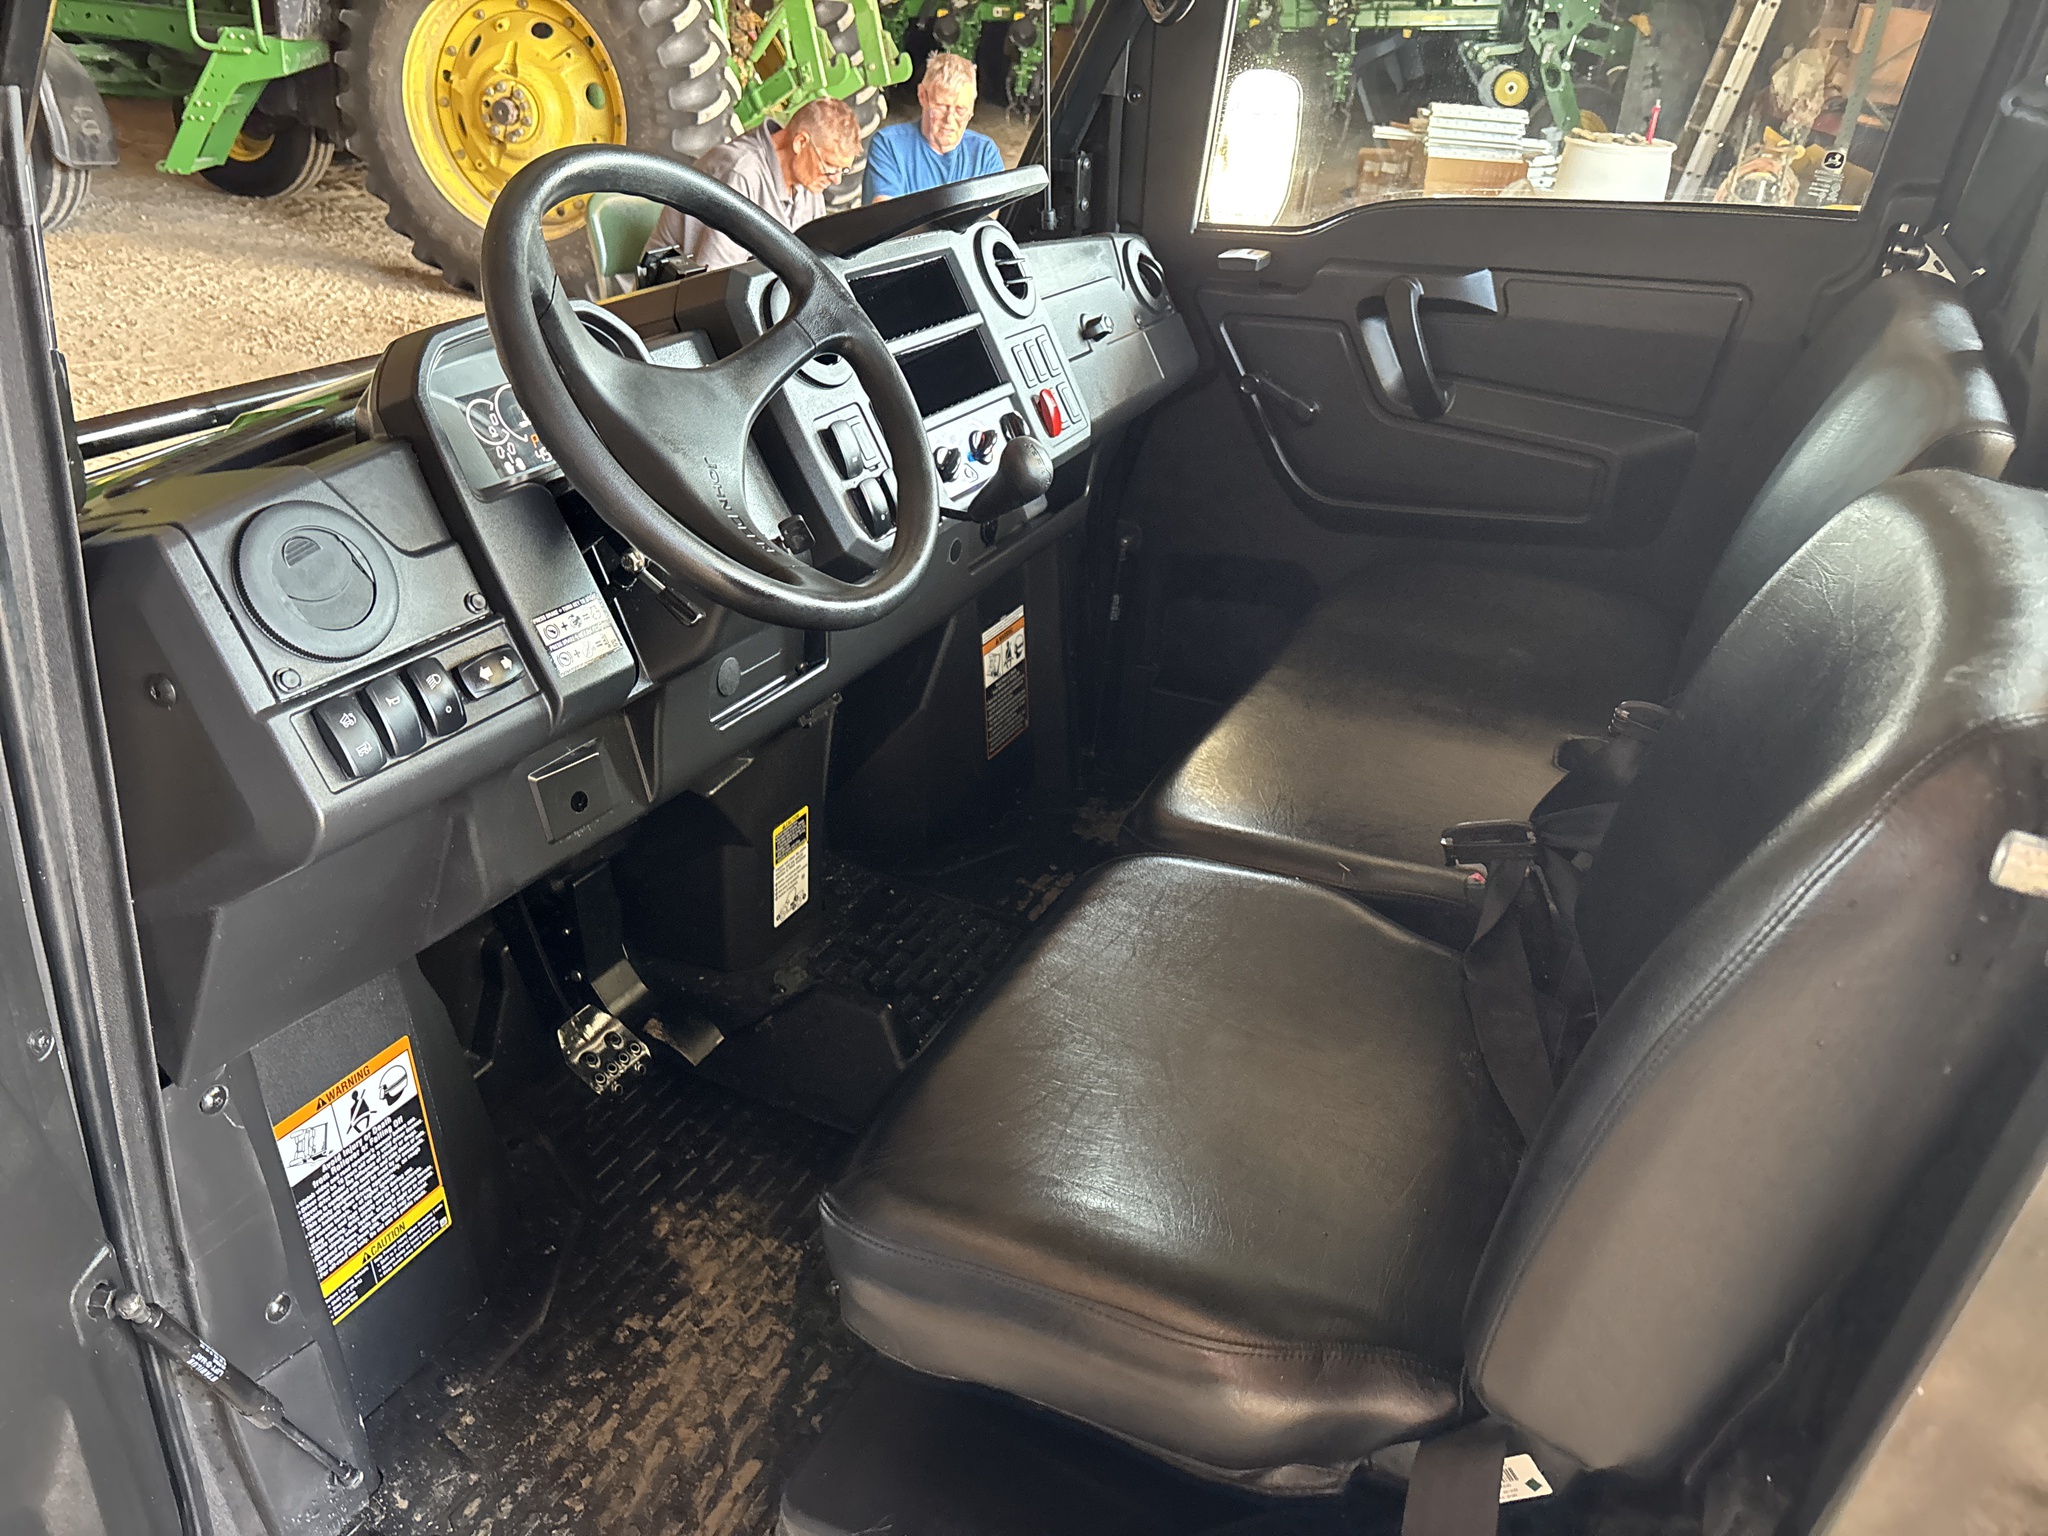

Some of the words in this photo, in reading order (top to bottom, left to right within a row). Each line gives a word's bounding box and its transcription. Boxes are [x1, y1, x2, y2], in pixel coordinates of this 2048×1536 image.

[703, 456, 732, 512] JOHN
[727, 514, 783, 556] DEERE
[325, 1063, 371, 1102] WARNING
[311, 1169, 330, 1189] from
[329, 1147, 360, 1176] Rollover
[359, 1140, 369, 1153] or
[368, 1122, 393, 1147] Falling
[392, 1114, 404, 1129] Off
[320, 1151, 342, 1173] Avoid
[341, 1136, 363, 1158] Injury
[362, 1129, 372, 1142] or
[371, 1114, 392, 1136] Death
[369, 1219, 406, 1256] CAUTION
[186, 1358, 219, 1383] STABILUS
